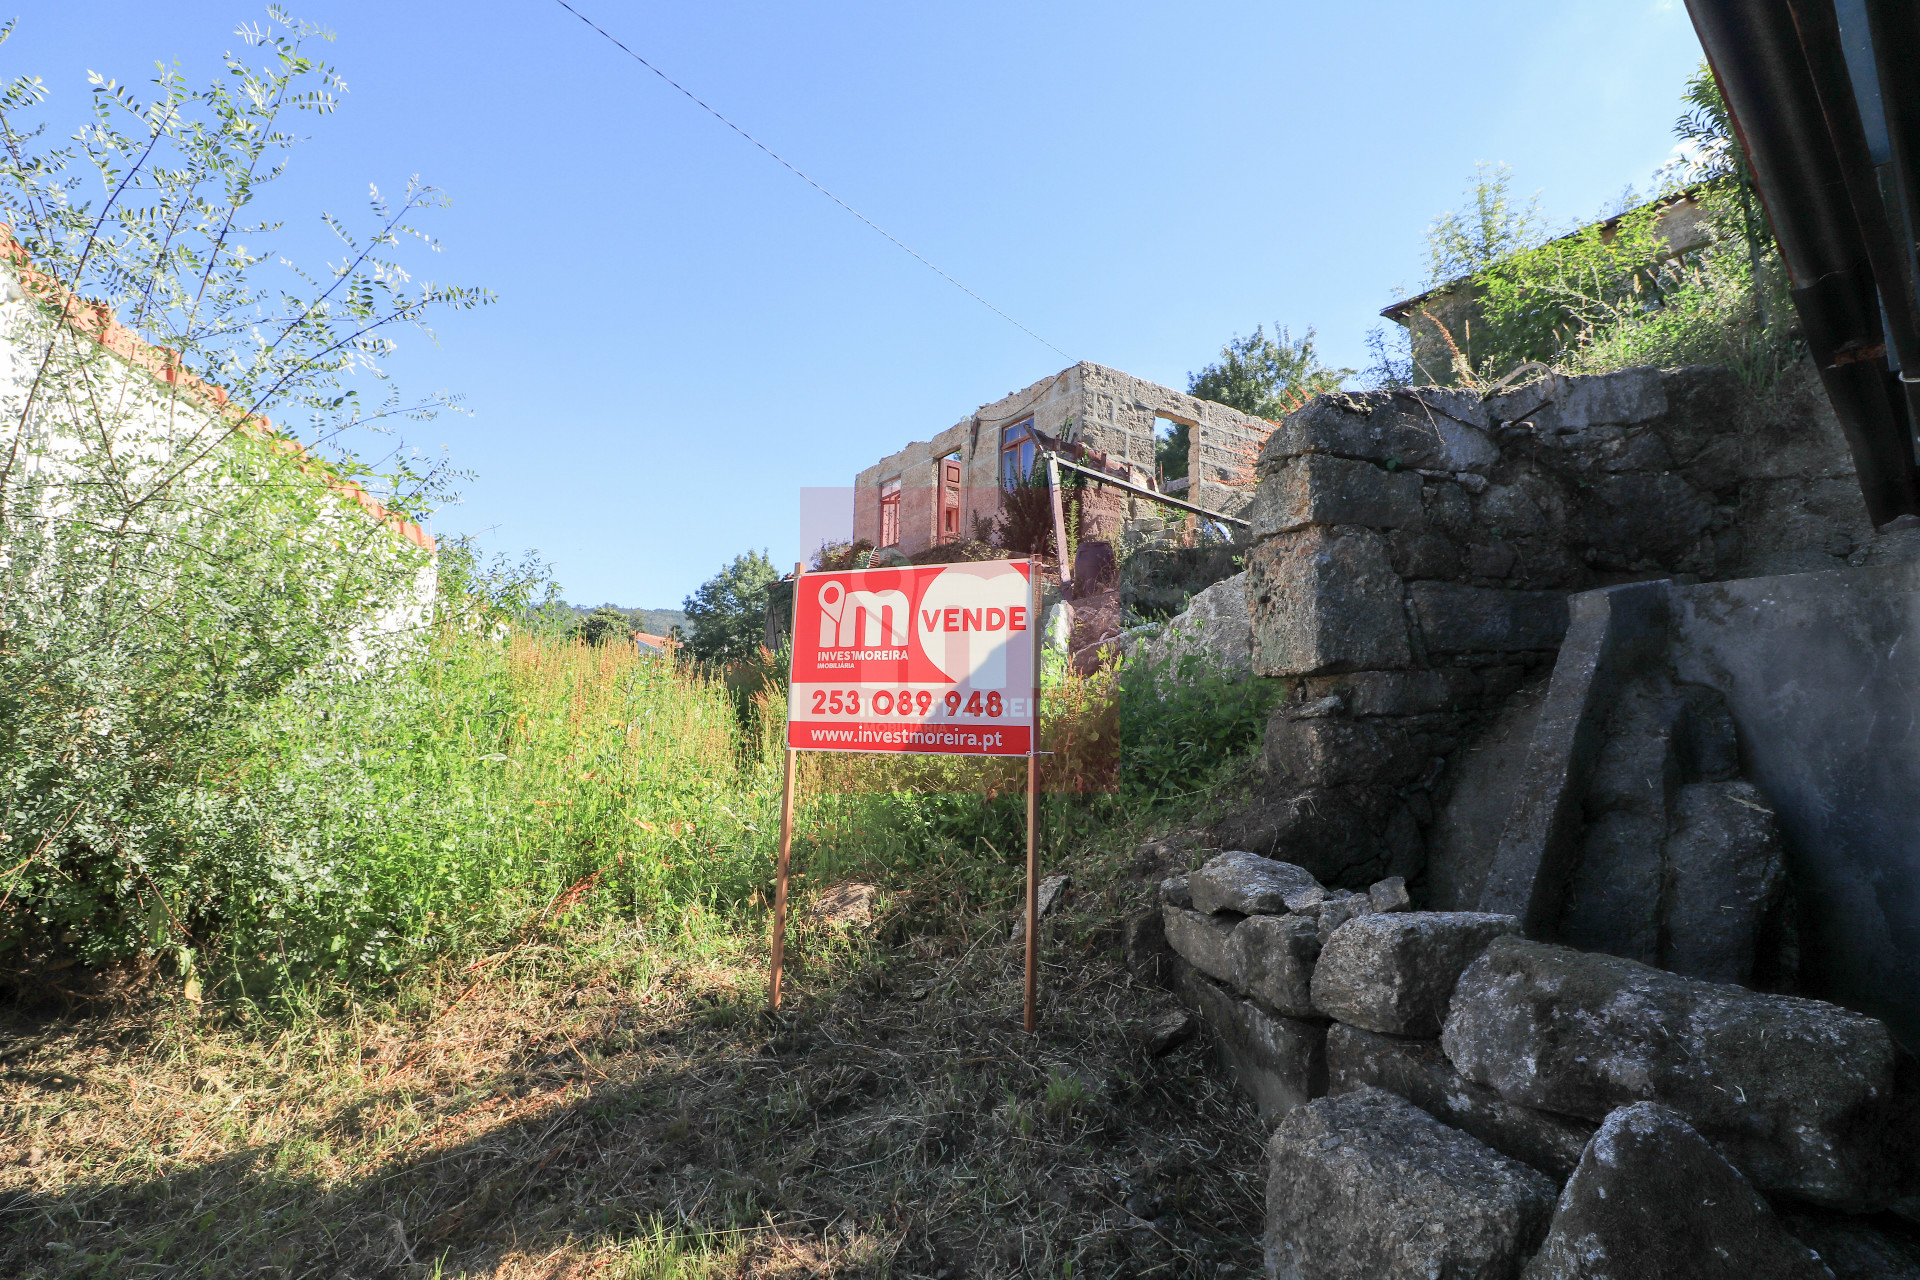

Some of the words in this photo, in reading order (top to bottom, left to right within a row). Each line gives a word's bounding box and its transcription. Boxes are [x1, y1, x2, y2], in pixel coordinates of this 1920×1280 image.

[922, 606, 1027, 632] VENDE
[817, 650, 909, 662] INVESTMOREIRA
[811, 689, 861, 715] 253
[872, 690, 933, 716] 089
[945, 690, 1003, 717] 948
[811, 725, 1003, 751] www.investmoreira.pt
